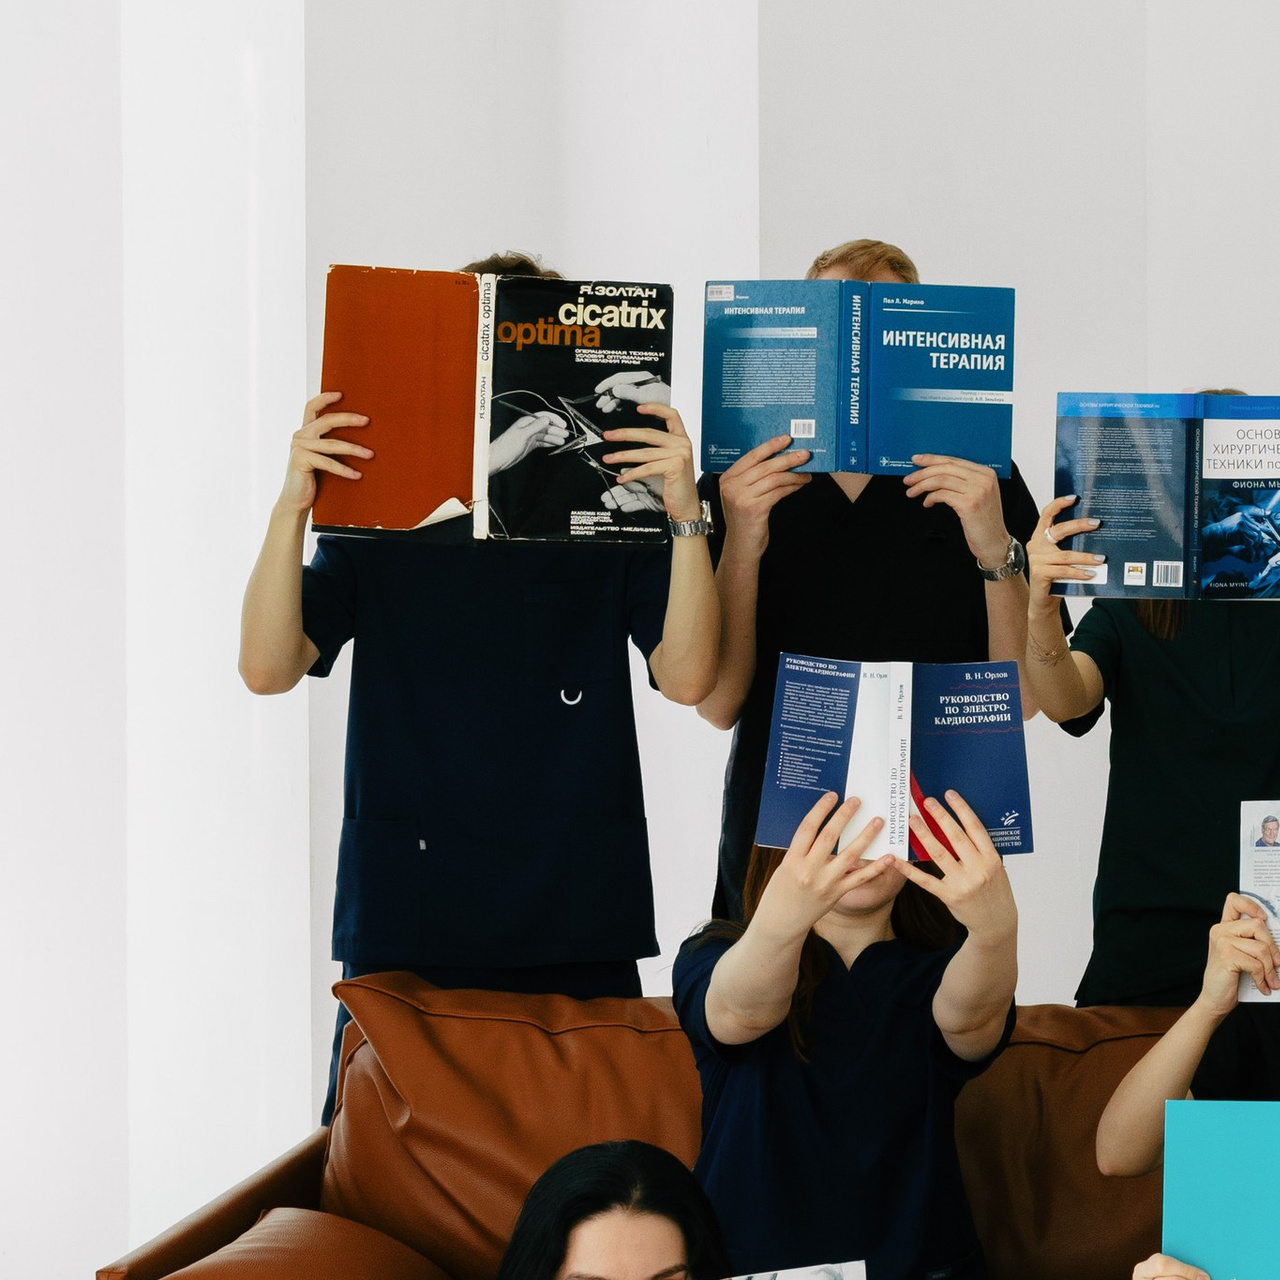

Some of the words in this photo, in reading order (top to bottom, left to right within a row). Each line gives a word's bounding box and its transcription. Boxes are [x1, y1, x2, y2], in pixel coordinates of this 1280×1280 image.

[481, 282, 492, 319] optima
[558, 297, 666, 330] cicatrix
[480, 323, 490, 361] cicatrix
[497, 317, 601, 351] optima
[851, 295, 861, 373] ИНТЕНСИВНАЯ
[883, 330, 1006, 350] ИНТЕНСИВНАЯ
[930, 352, 1005, 371] ТЕРАПИЯ
[850, 376, 860, 424] ТЕРАПИЯ
[1207, 458, 1263, 470] ТЕХНИКИ
[785, 664, 855, 678] ЭЛЕКТРОКАРДИОГРАФИИ
[786, 657, 827, 669] РУКОВОДСТВО
[985, 672, 1008, 680] Орлов
[940, 693, 1009, 704] РУКОВОДСТВО
[945, 706, 959, 714] ПО
[963, 703, 1010, 713] ЭЛЕКТРО-
[934, 714, 1011, 725] КАРДИОГРАФИИ
[891, 767, 897, 780] ПО
[898, 739, 907, 845] ЭЛЕКТРОКАРДИОГРАФИИ
[889, 783, 897, 845] РУКОВОДСТВО
